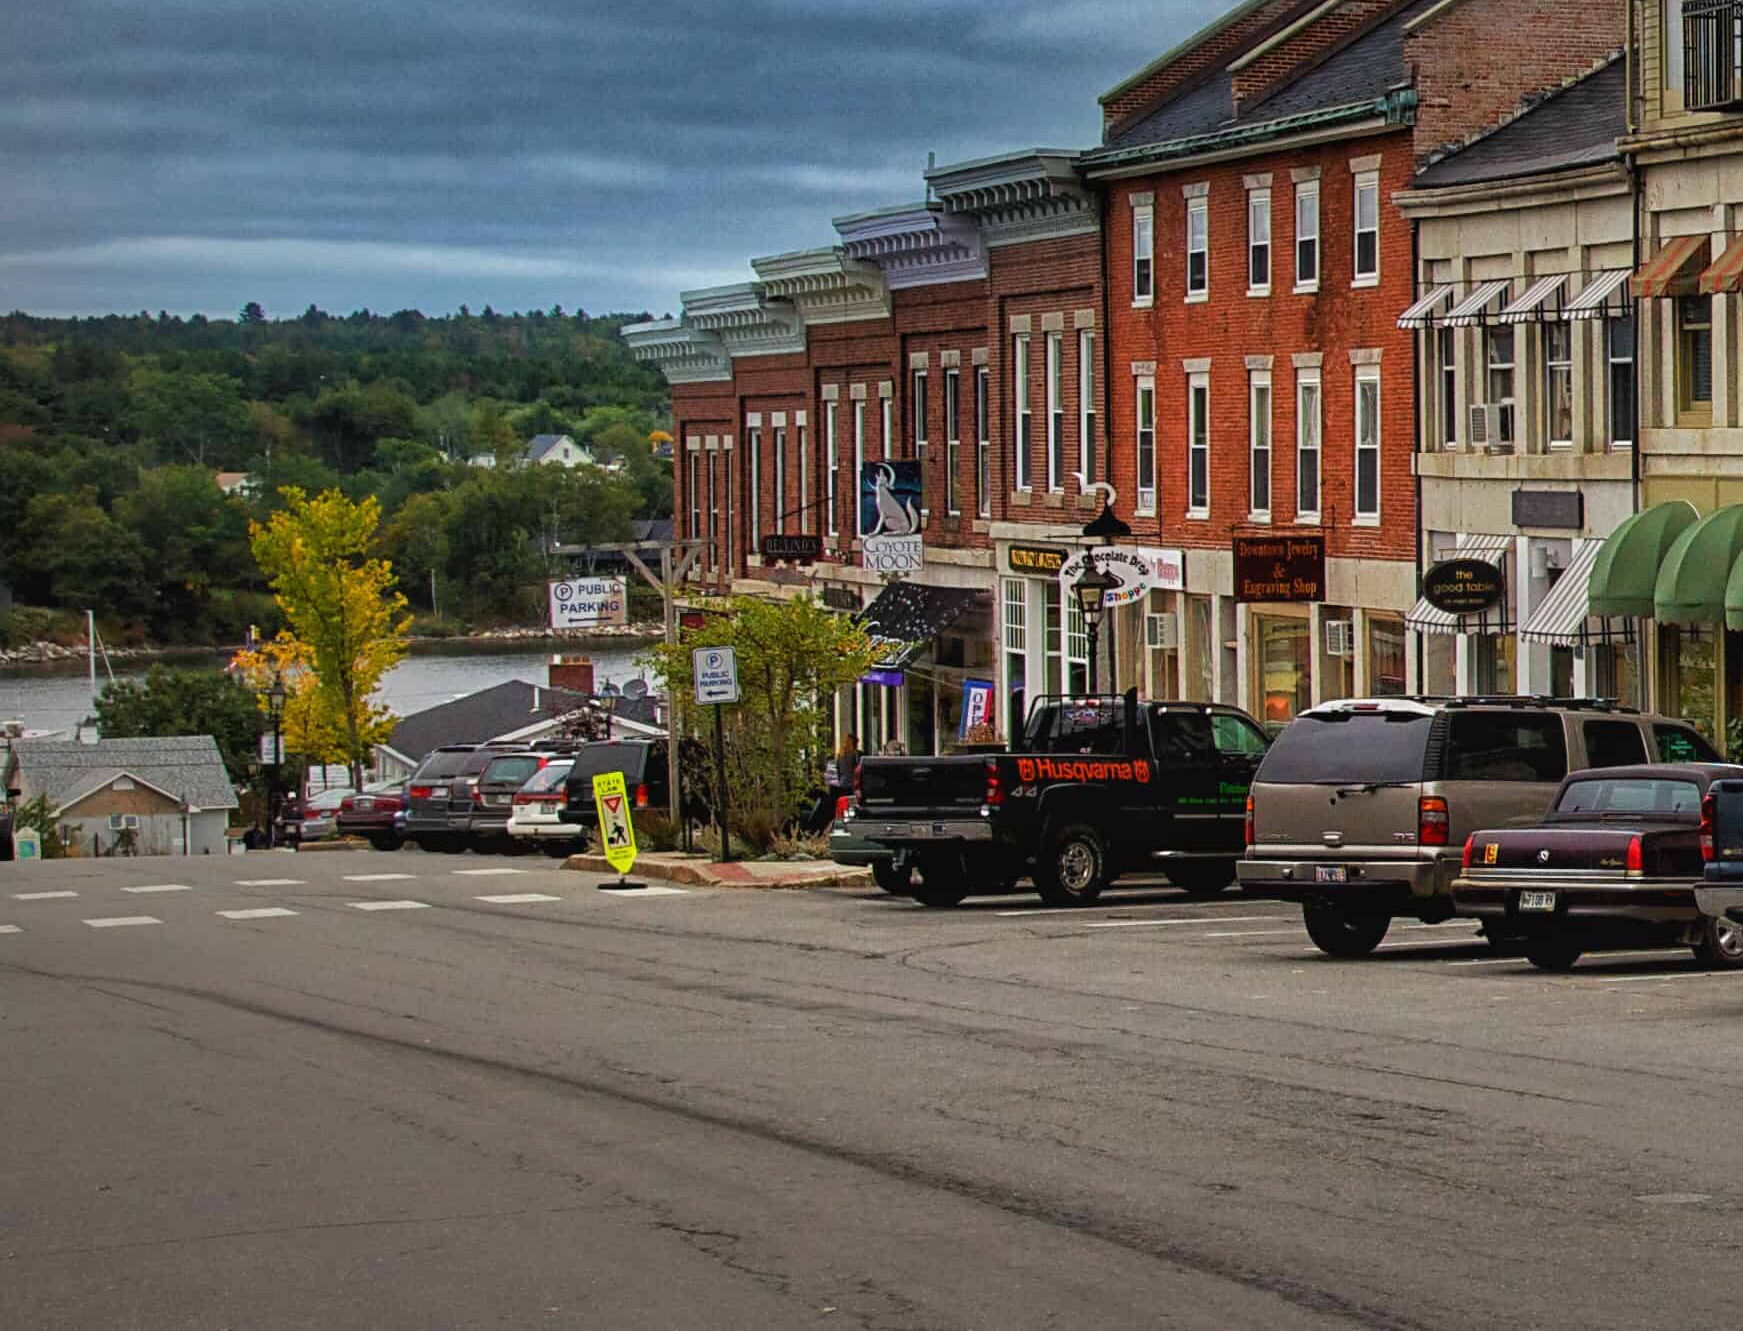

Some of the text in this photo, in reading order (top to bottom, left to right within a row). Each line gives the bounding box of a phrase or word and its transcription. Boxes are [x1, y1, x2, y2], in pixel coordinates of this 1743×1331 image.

[863, 539, 922, 554] COYOTE
[864, 554, 922, 569] MOON
[1243, 577, 1318, 599] Engraving Shop
[1433, 582, 1464, 596] good
[559, 600, 620, 614] PARKING
[701, 669, 730, 679] PUBLIC
[699, 677, 733, 687] PARKING
[1036, 758, 1133, 783] Husqvarna
